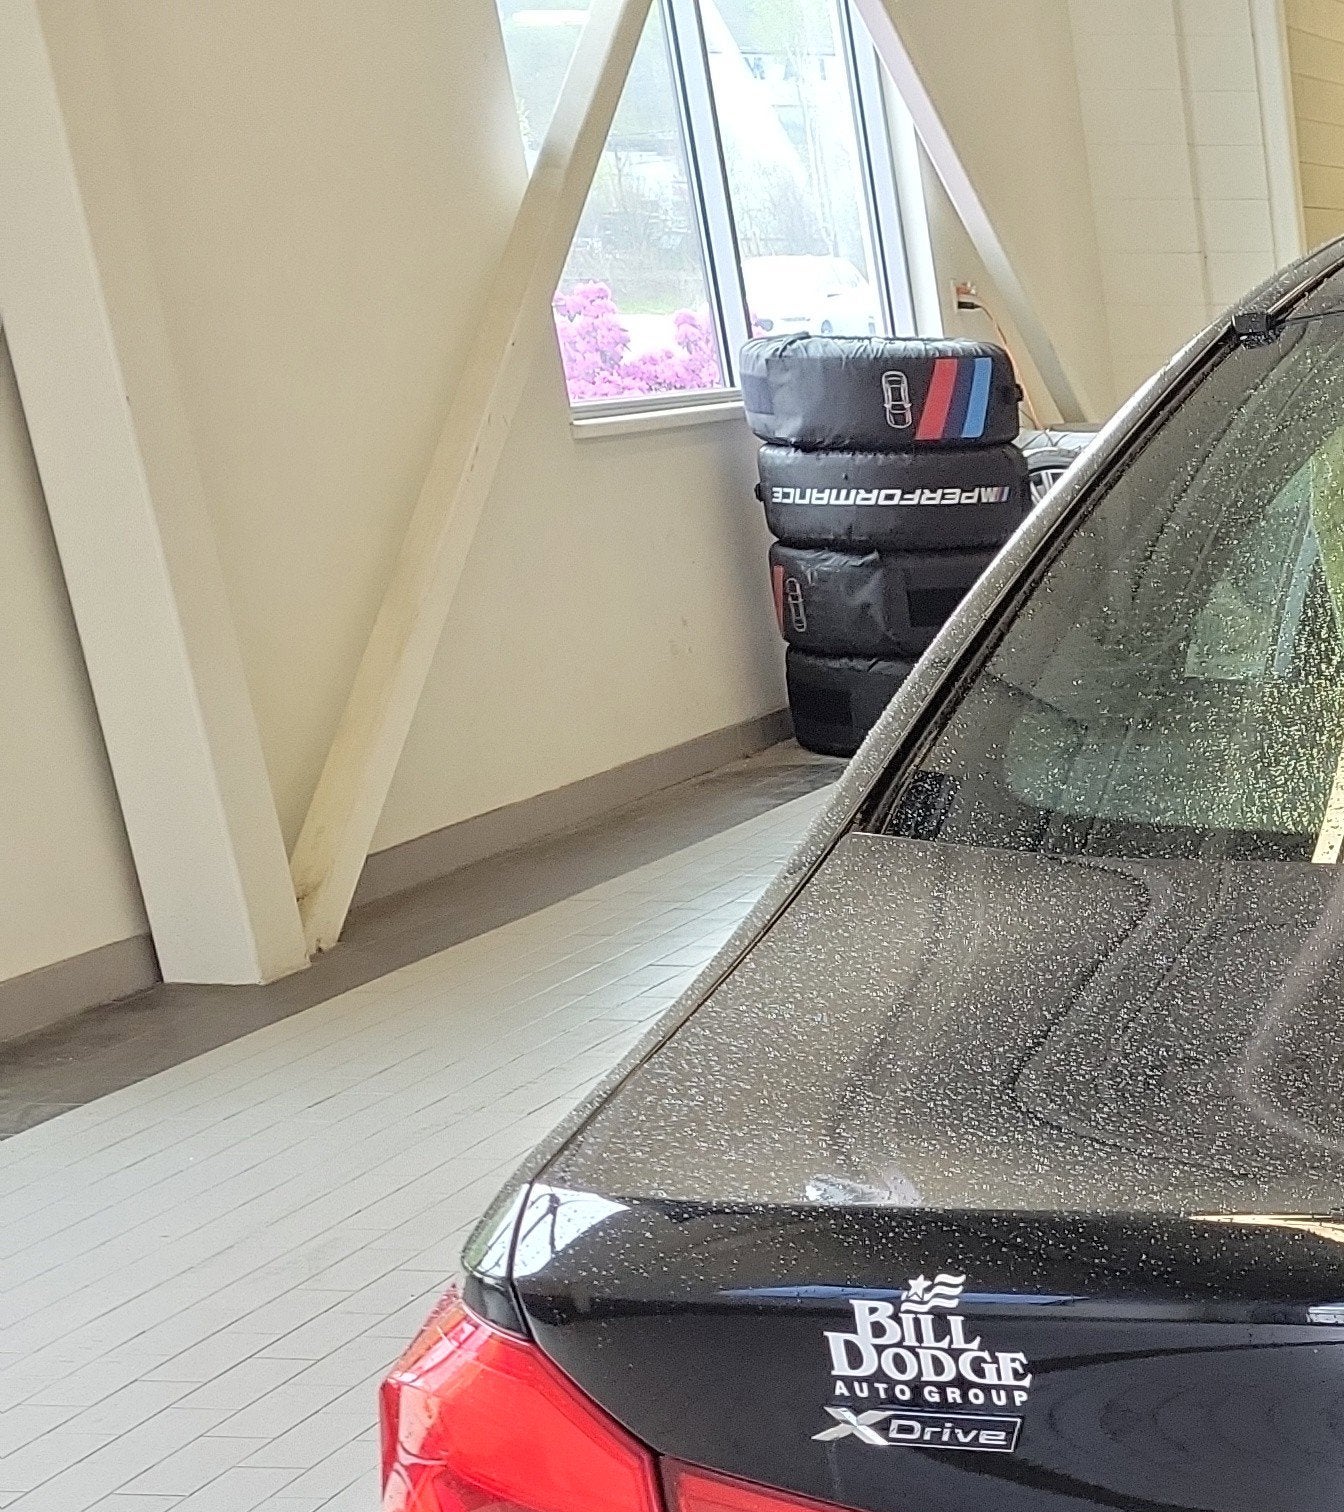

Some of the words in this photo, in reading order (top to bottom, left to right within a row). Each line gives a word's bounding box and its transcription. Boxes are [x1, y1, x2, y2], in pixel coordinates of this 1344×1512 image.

[849, 1299, 981, 1350] BILL
[823, 1331, 1033, 1388] DODGE
[834, 1380, 911, 1401] AUTO
[923, 1385, 1028, 1407] GROUP
